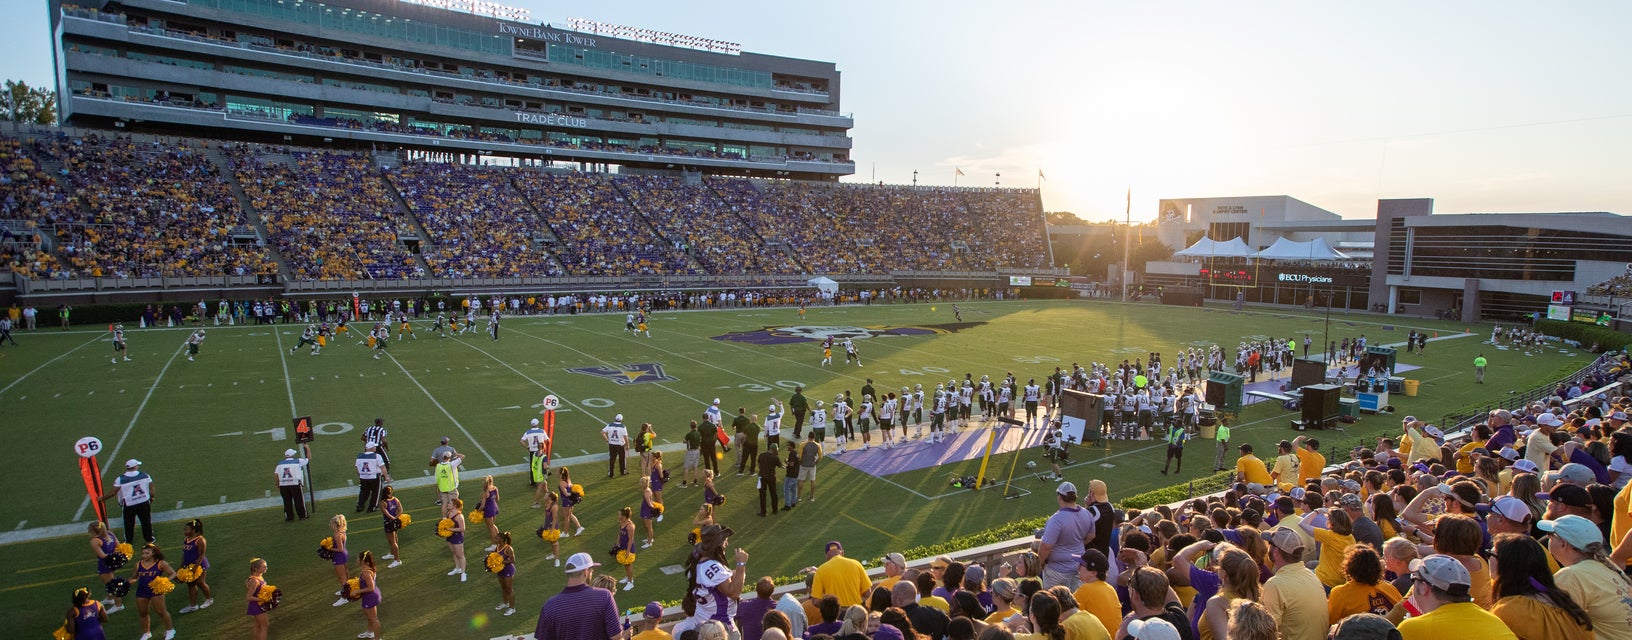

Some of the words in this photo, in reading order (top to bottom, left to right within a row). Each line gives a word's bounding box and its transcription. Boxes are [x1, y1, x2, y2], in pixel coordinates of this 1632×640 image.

[563, 32, 596, 48] TOWER
[515, 112, 554, 125] TRADE
[557, 117, 587, 128] CLUB
[1285, 272, 1301, 282] ECU
[1302, 273, 1332, 283] Physicians
[738, 380, 807, 392] 30
[545, 398, 557, 407] P6
[818, 414, 824, 422] 5
[296, 419, 310, 433] 4
[78, 441, 99, 454] P6
[704, 563, 720, 580] 65
